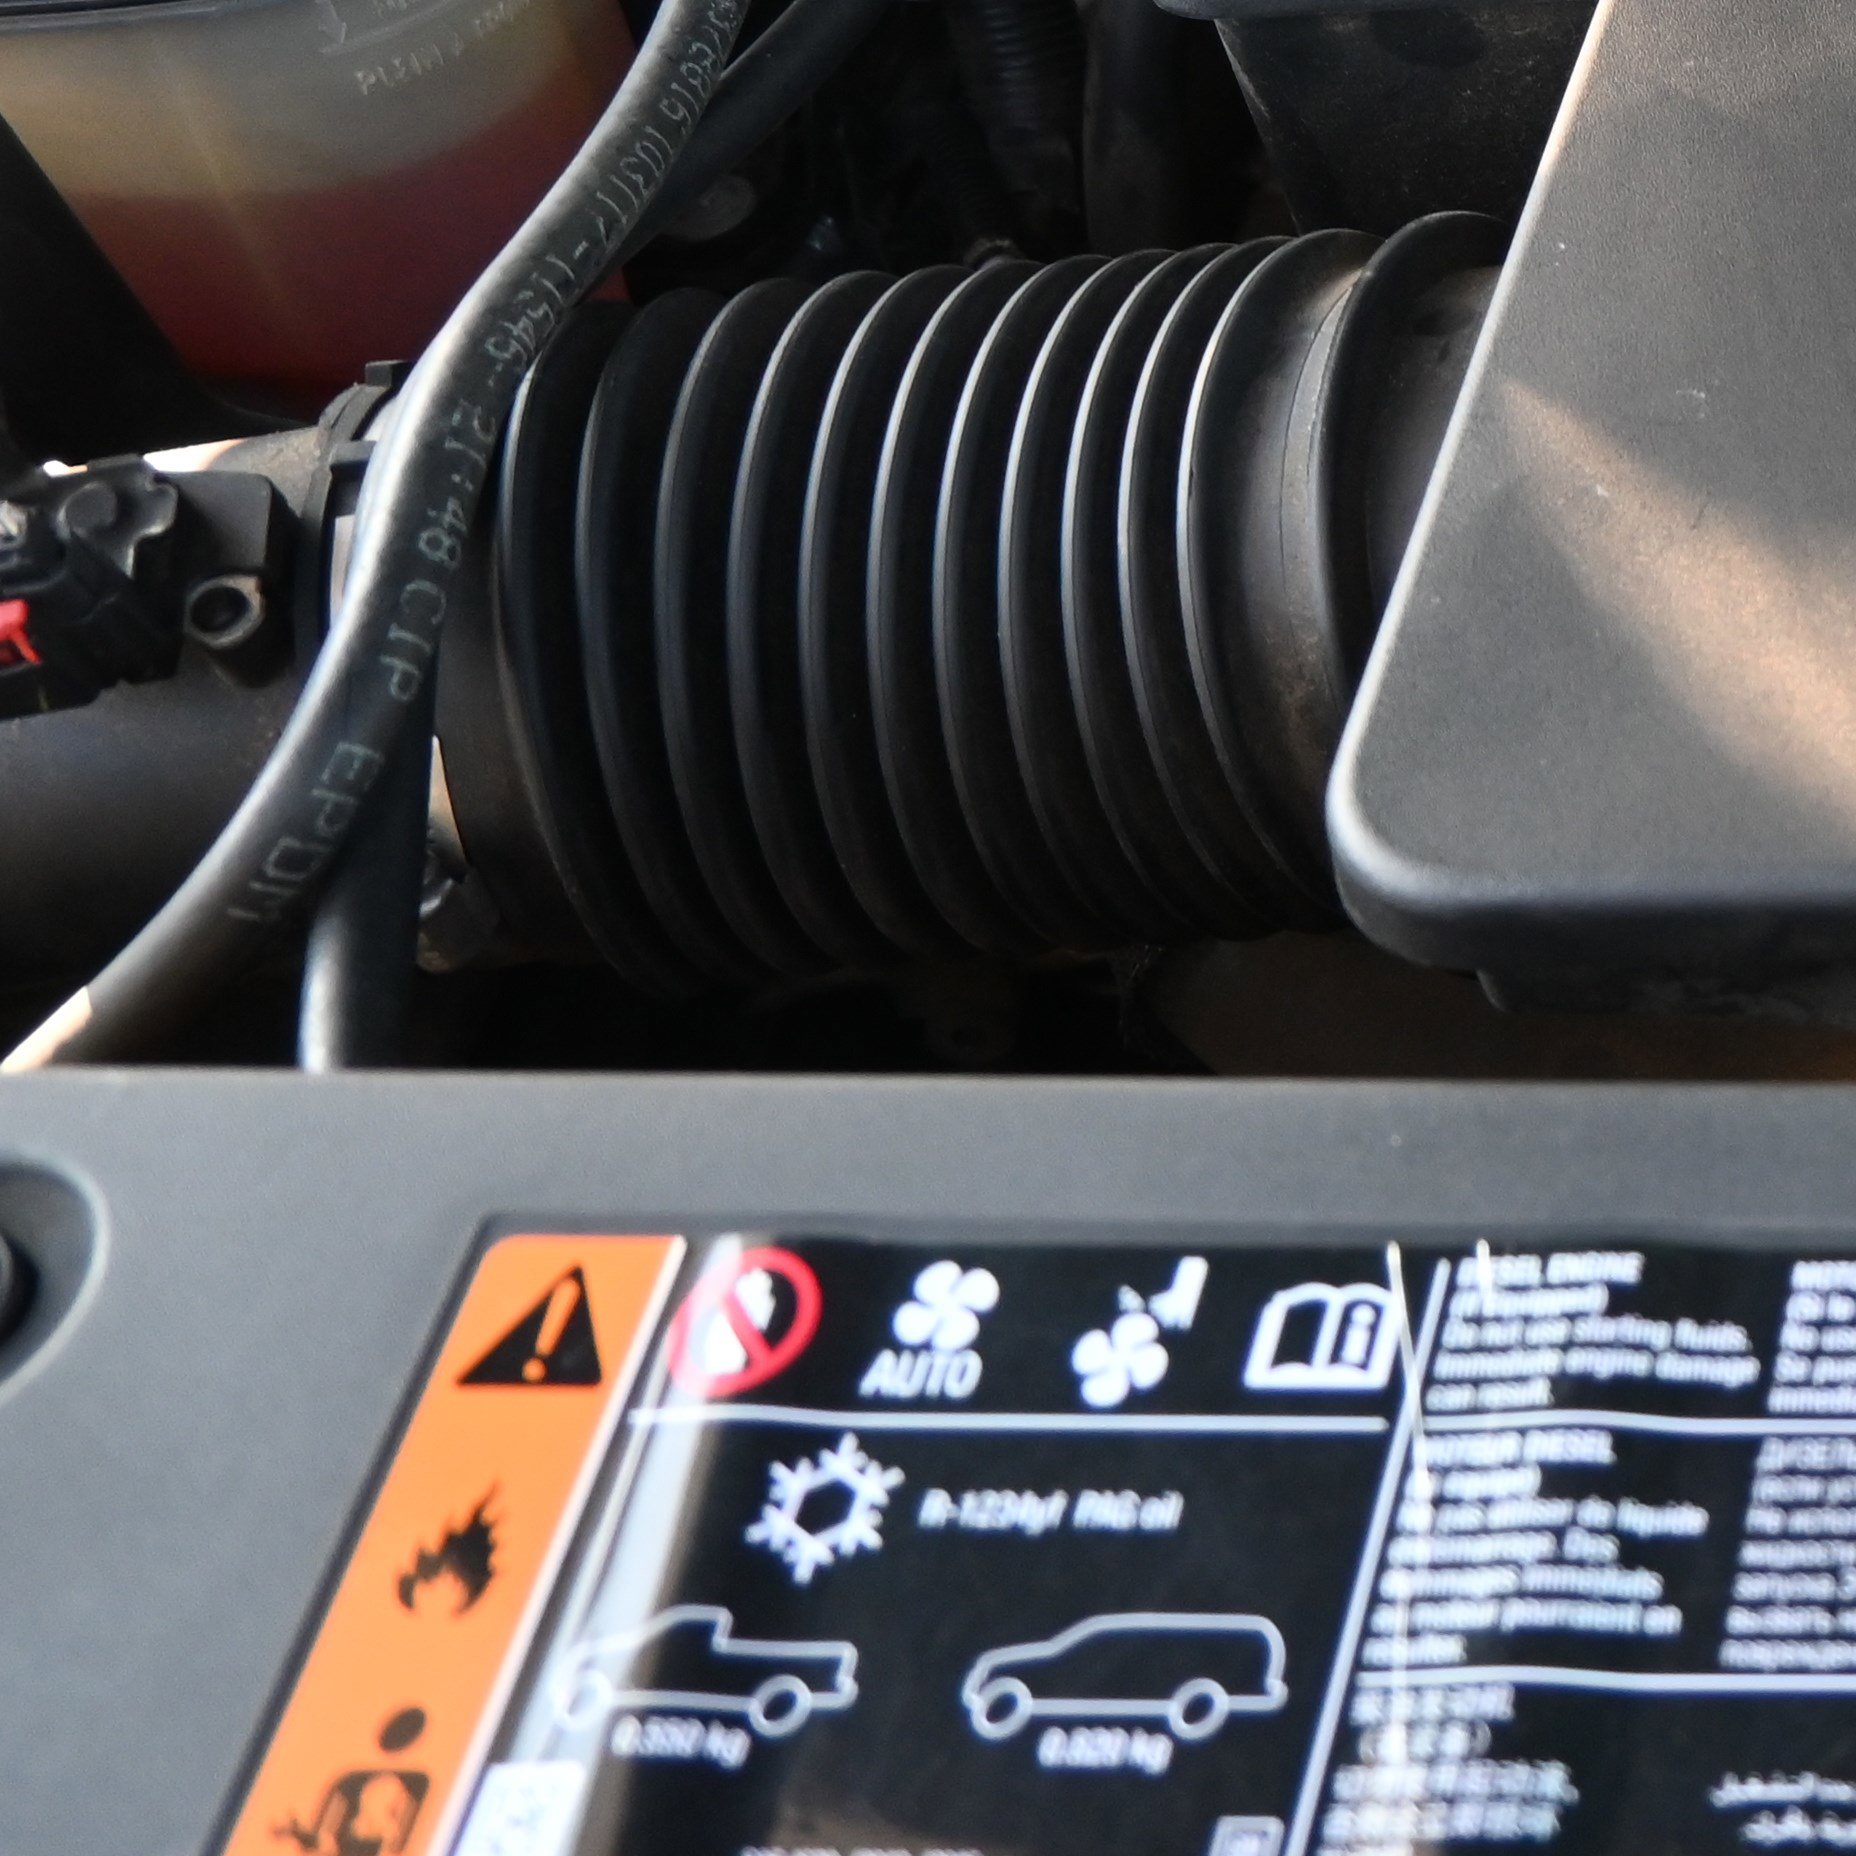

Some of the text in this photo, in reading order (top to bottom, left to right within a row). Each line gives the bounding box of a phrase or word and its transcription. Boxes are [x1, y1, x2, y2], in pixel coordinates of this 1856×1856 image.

[418, 400, 497, 571] 21:48
[380, 580, 447, 702] CIP
[227, 742, 385, 922] EPDM
[859, 1348, 982, 1399] AUTO
[1130, 1727, 1174, 1776] kg
